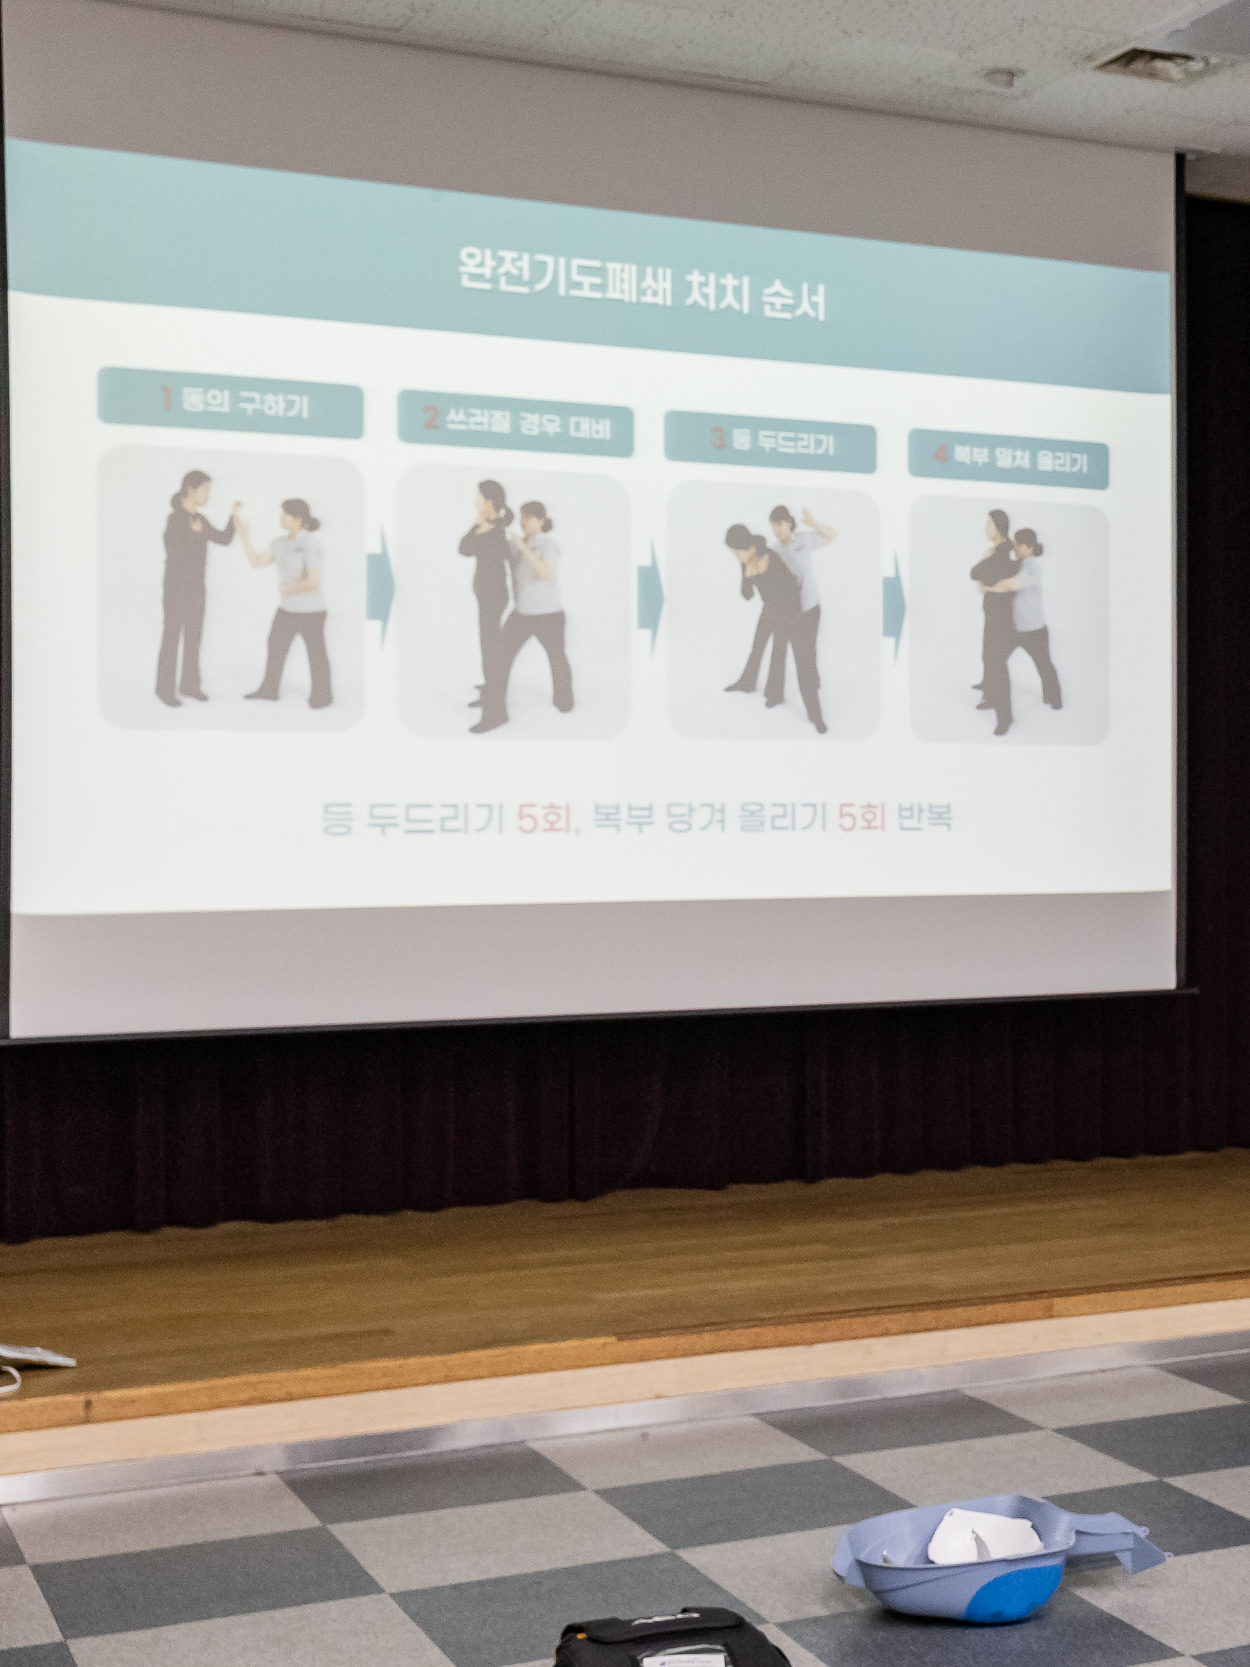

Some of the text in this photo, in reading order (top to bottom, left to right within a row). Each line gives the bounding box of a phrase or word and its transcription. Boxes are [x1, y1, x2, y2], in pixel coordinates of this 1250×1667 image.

[458, 246, 826, 322] 완전기도폐쇄 처치 순서
[161, 385, 309, 419] 1 동의 구하기
[423, 405, 612, 441] 2 쓰러질 경우 대비
[711, 427, 726, 450] 3
[758, 430, 835, 456] 두드리기
[933, 443, 948, 463] 4
[1036, 450, 1089, 474] 올리기
[321, 801, 954, 838] 등 두드리기 5회, 복부 당겨 올리기 5회 반복
